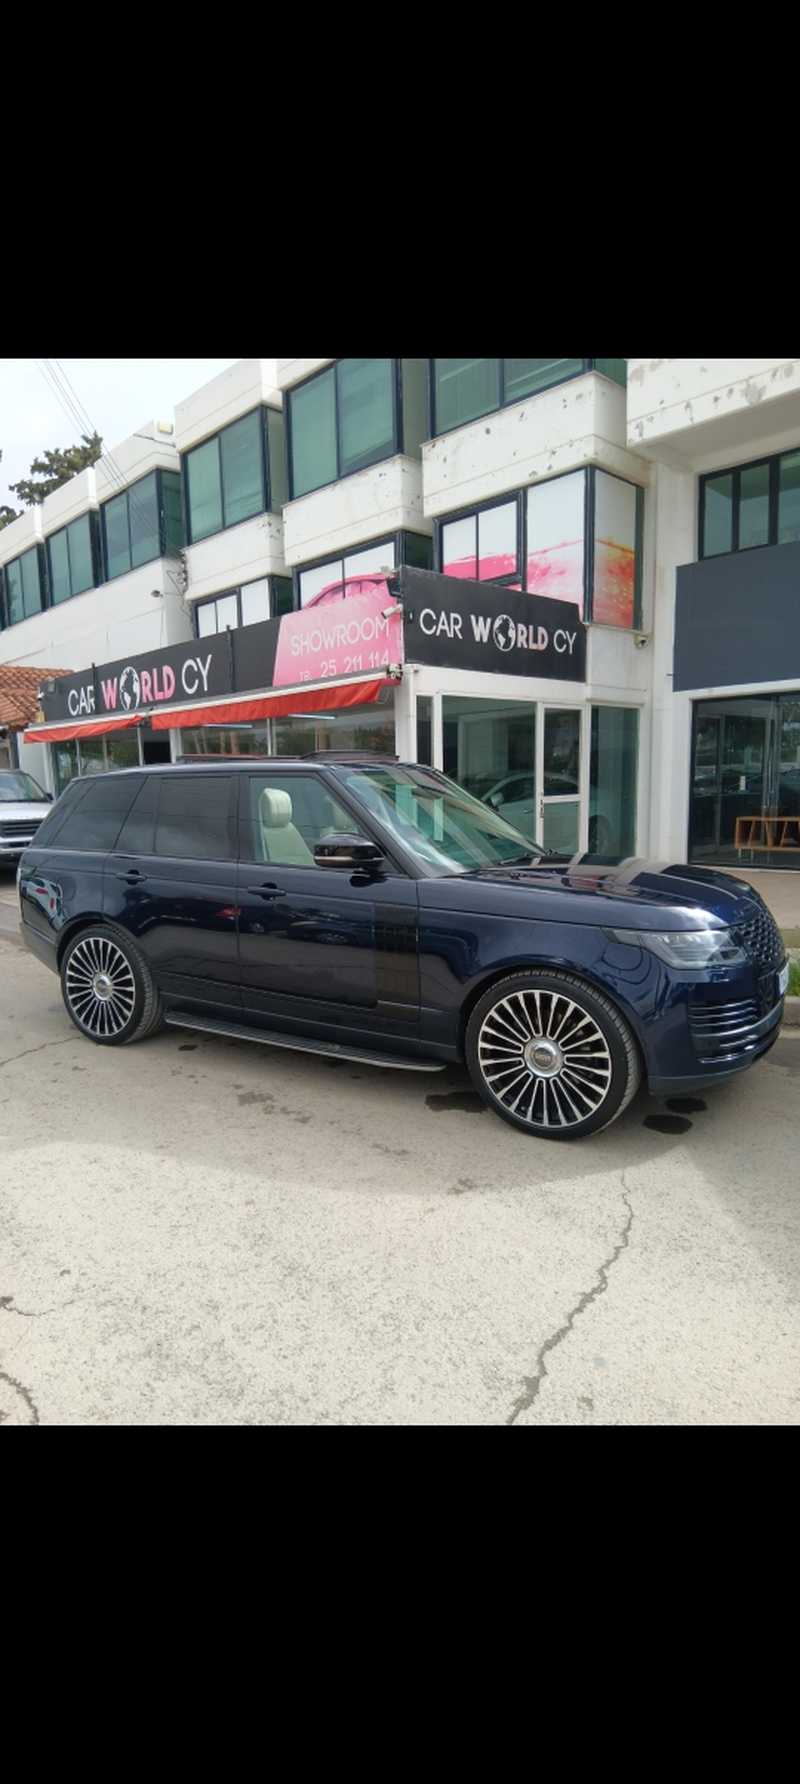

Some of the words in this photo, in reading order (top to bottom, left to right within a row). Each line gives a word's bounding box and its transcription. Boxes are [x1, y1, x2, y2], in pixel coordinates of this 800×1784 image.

[290, 615, 390, 656] SHOWROOM
[419, 608, 463, 640] CAR
[470, 613, 549, 652] WORLD
[553, 628, 577, 655] CY
[181, 654, 212, 695] CY
[320, 659, 337, 678] 25
[344, 654, 363, 674] 211
[368, 649, 390, 669] 114
